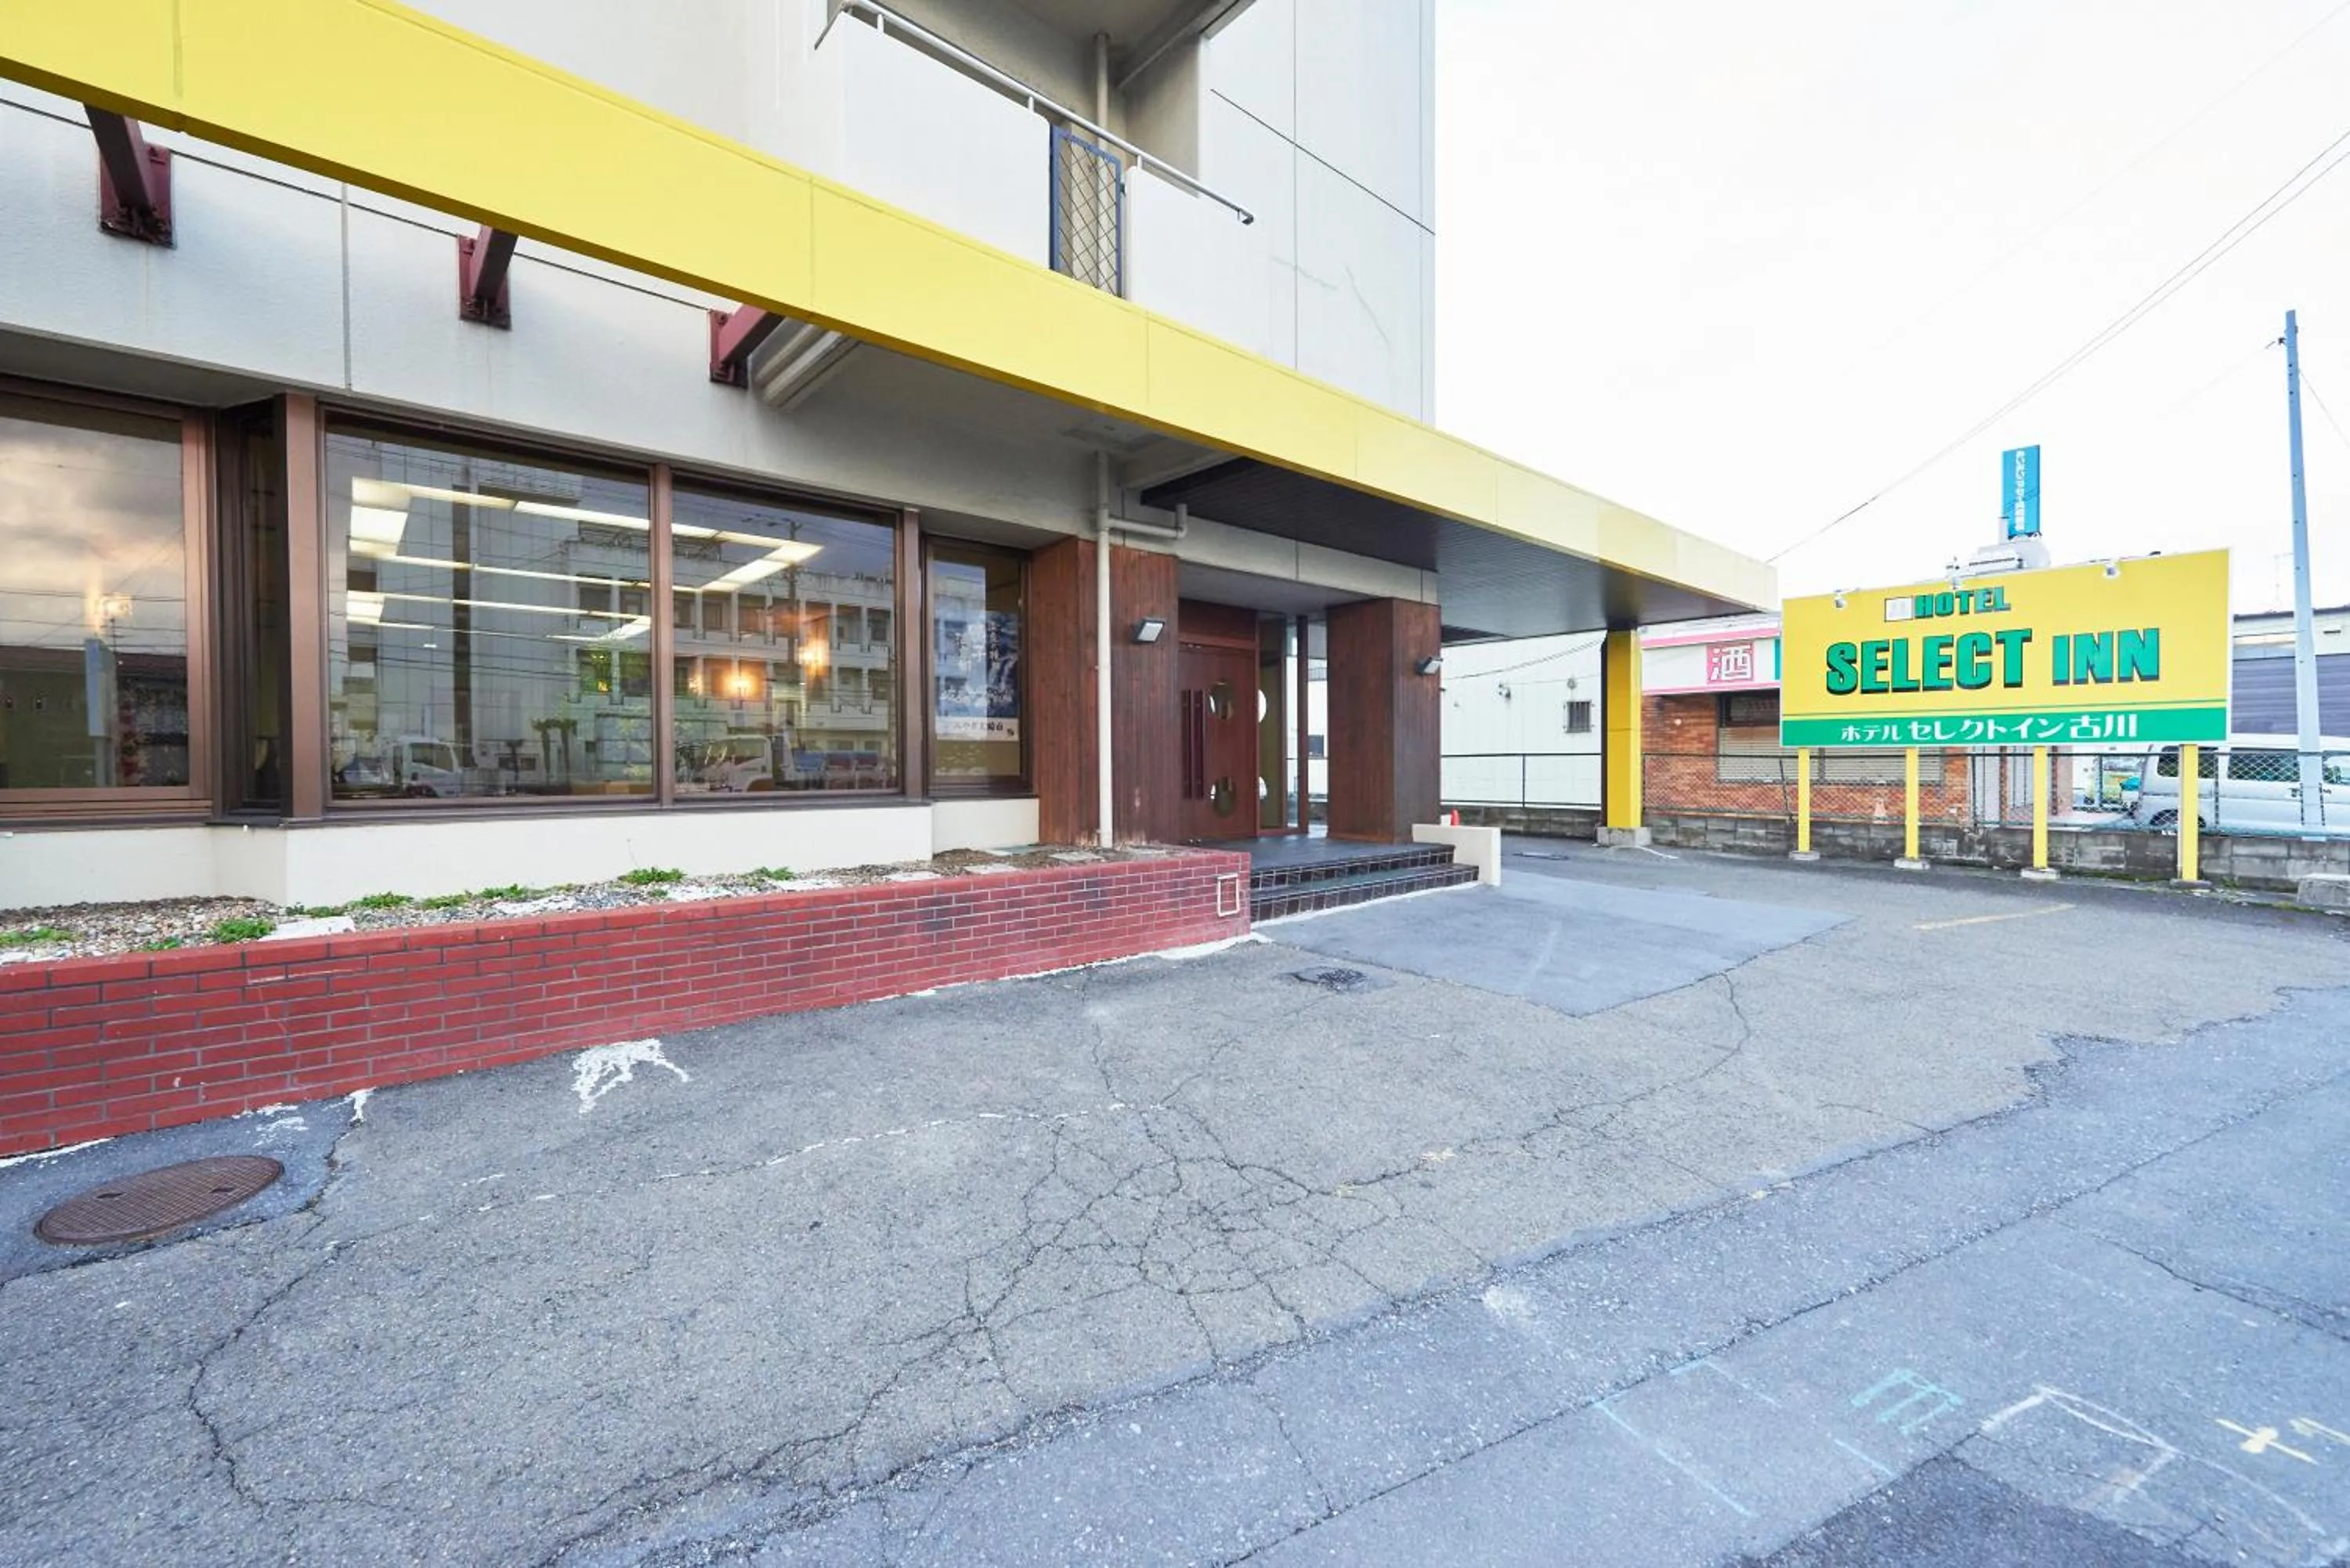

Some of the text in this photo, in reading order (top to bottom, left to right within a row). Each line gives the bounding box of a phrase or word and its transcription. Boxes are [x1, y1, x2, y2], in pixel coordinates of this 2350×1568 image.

[1914, 586, 2011, 619] HOTEL
[1710, 645, 1752, 681] 酒
[1826, 628, 2160, 695] SELECT INN
